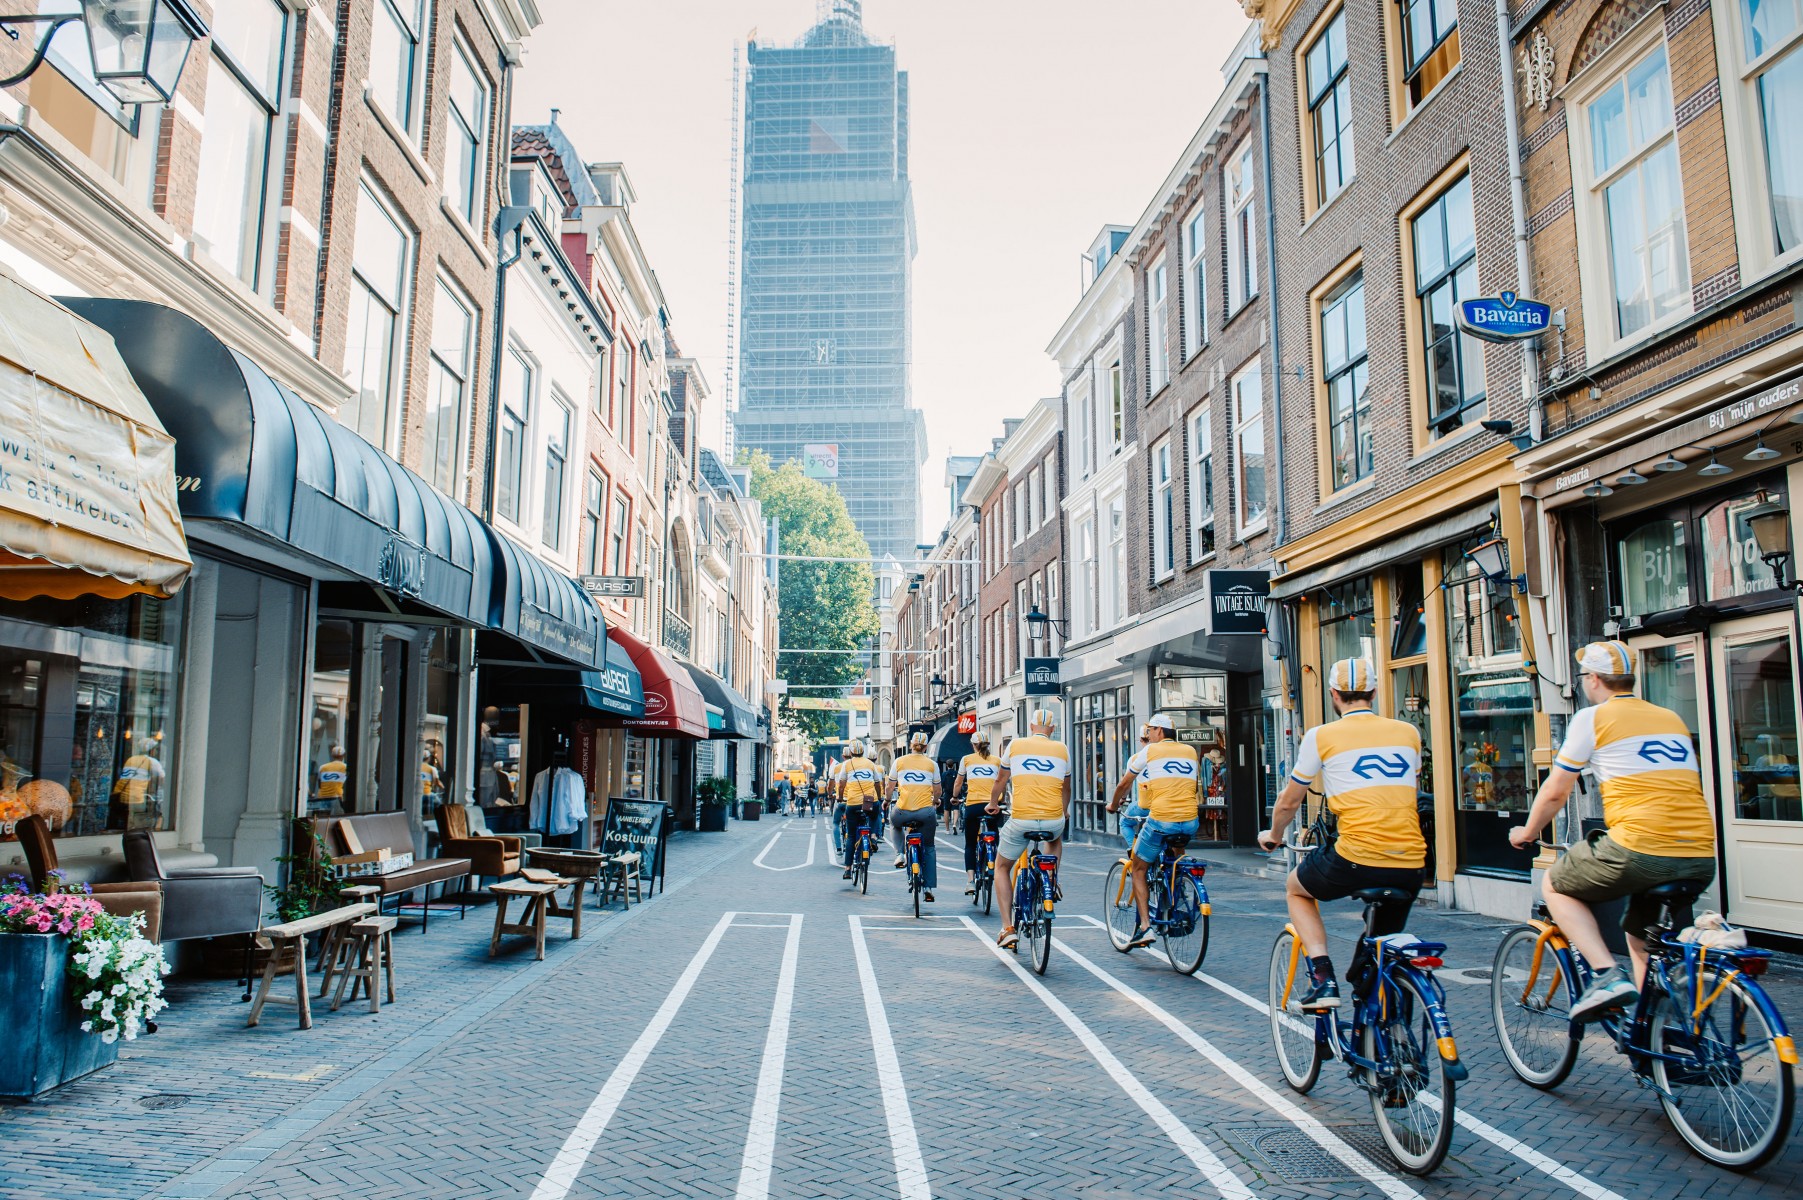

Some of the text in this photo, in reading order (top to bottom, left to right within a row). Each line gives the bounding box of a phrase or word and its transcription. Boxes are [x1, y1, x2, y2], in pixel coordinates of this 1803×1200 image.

[1473, 307, 1542, 325] Bavaria
[1709, 412, 1725, 429] Bij
[1758, 382, 1800, 409] ouders
[1556, 466, 1590, 491] Bavaria
[1641, 545, 1672, 586] Bij
[586, 582, 636, 592] BARSOI
[1721, 584, 1734, 598] en
[1215, 595, 1243, 613] VINTAGE
[1027, 672, 1059, 684] VINTAGE ISLAND
[959, 717, 975, 731] illy
[1181, 732, 1196, 740] VINTAGE
[605, 830, 658, 845] Kostuum
